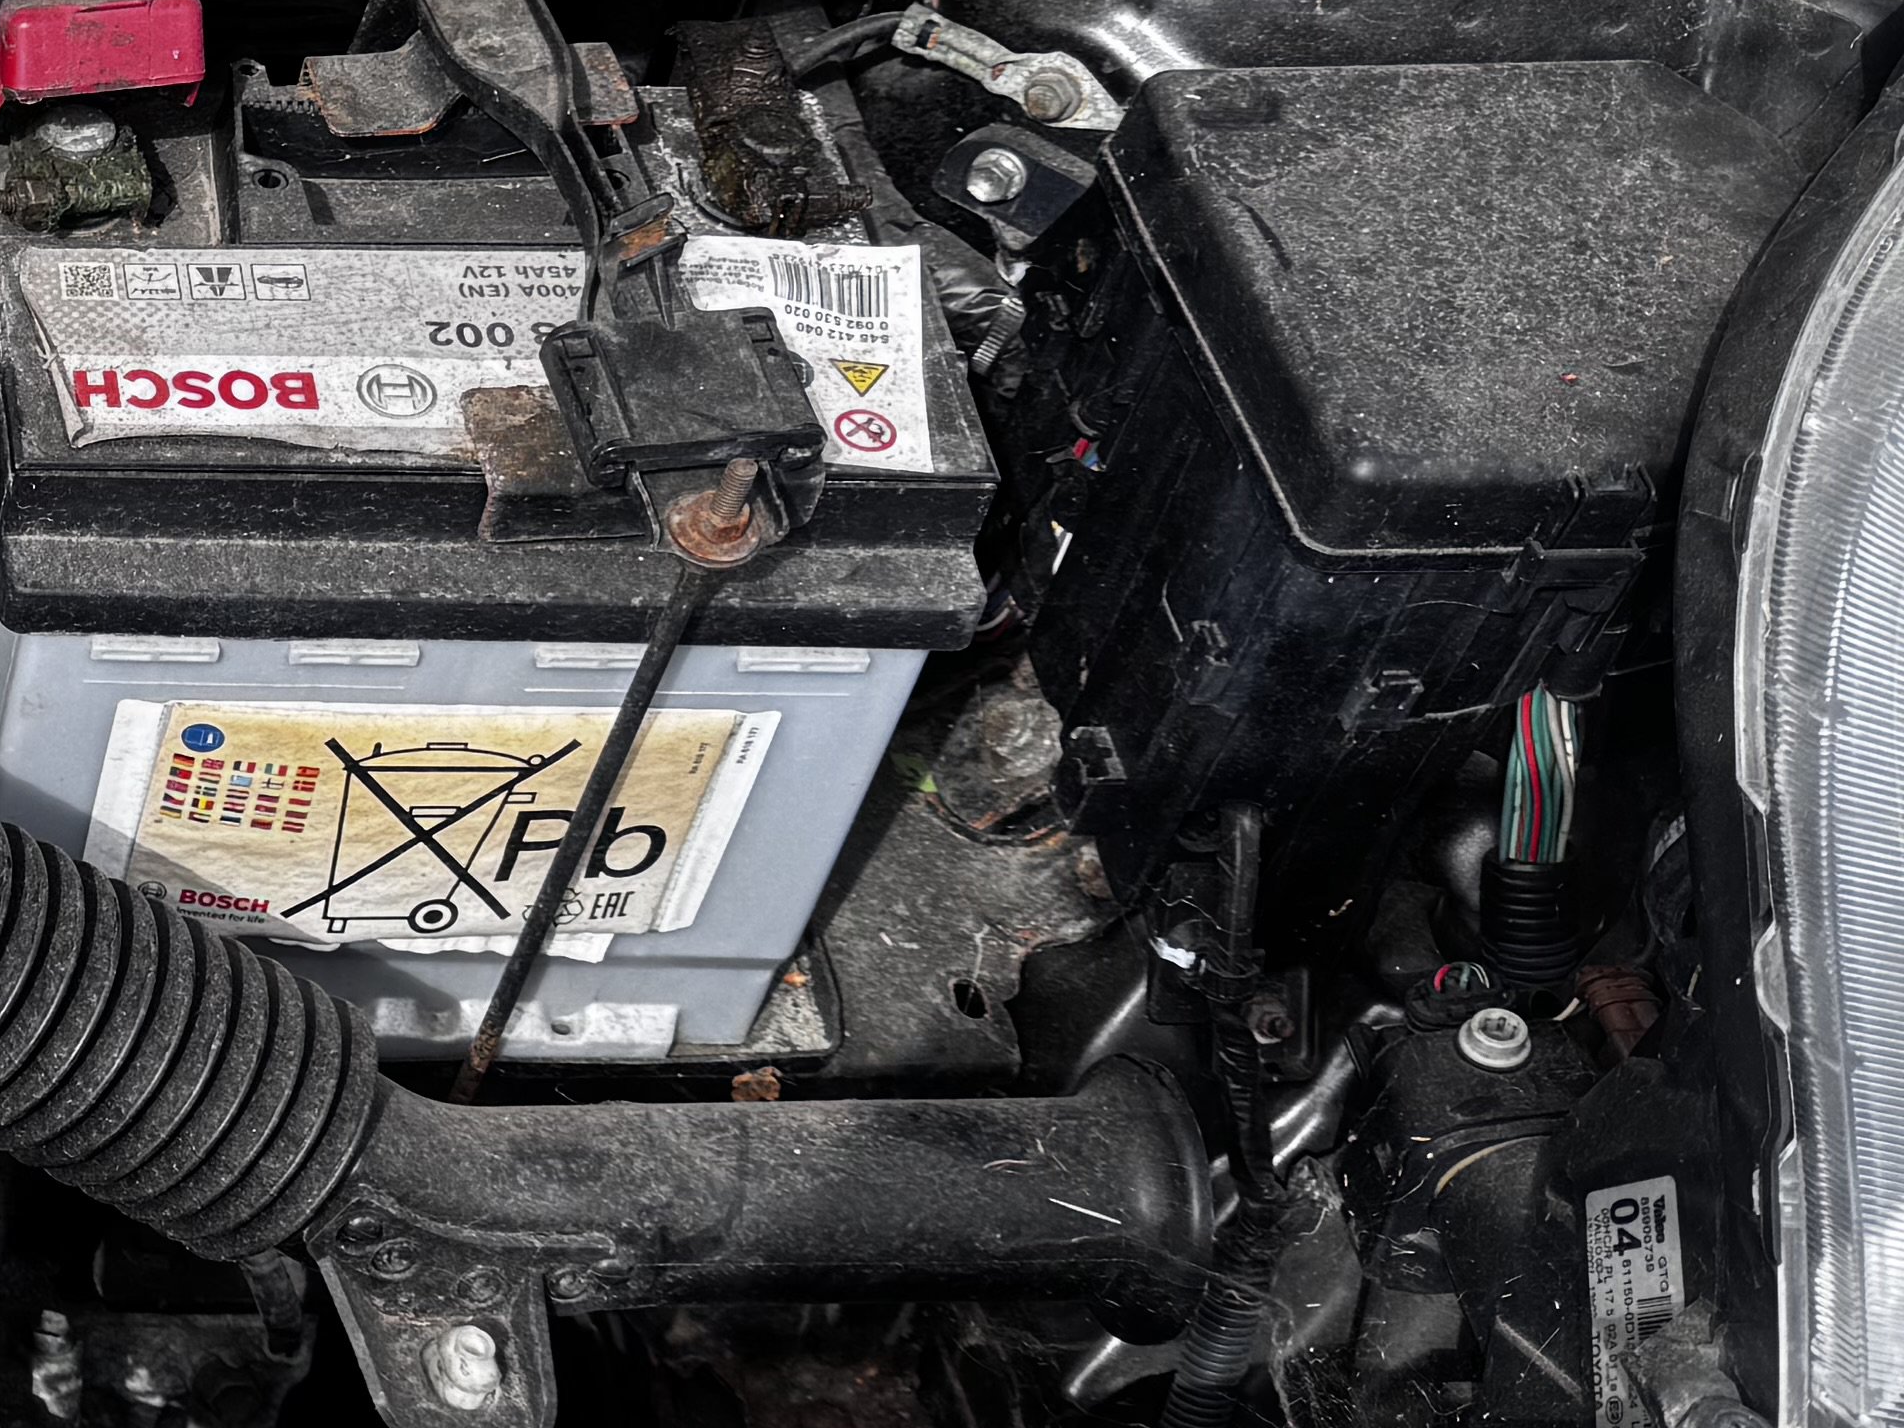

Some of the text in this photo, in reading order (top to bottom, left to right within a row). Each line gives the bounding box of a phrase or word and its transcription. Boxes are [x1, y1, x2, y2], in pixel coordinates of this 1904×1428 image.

[462, 265, 577, 279] 45Ah 12V
[458, 283, 582, 298] 400A (EN)
[784, 304, 809, 319] 020
[425, 322, 514, 348] 002
[796, 322, 823, 336] 040
[73, 369, 319, 411] BOSCH
[494, 809, 669, 883] Pb
[179, 889, 269, 913] BOSCH
[588, 891, 635, 920] EAC
[229, 913, 245, 923] for
[246, 914, 265, 924] life
[1609, 1198, 1642, 1256] 04
[1653, 1194, 1667, 1244] Valeo
